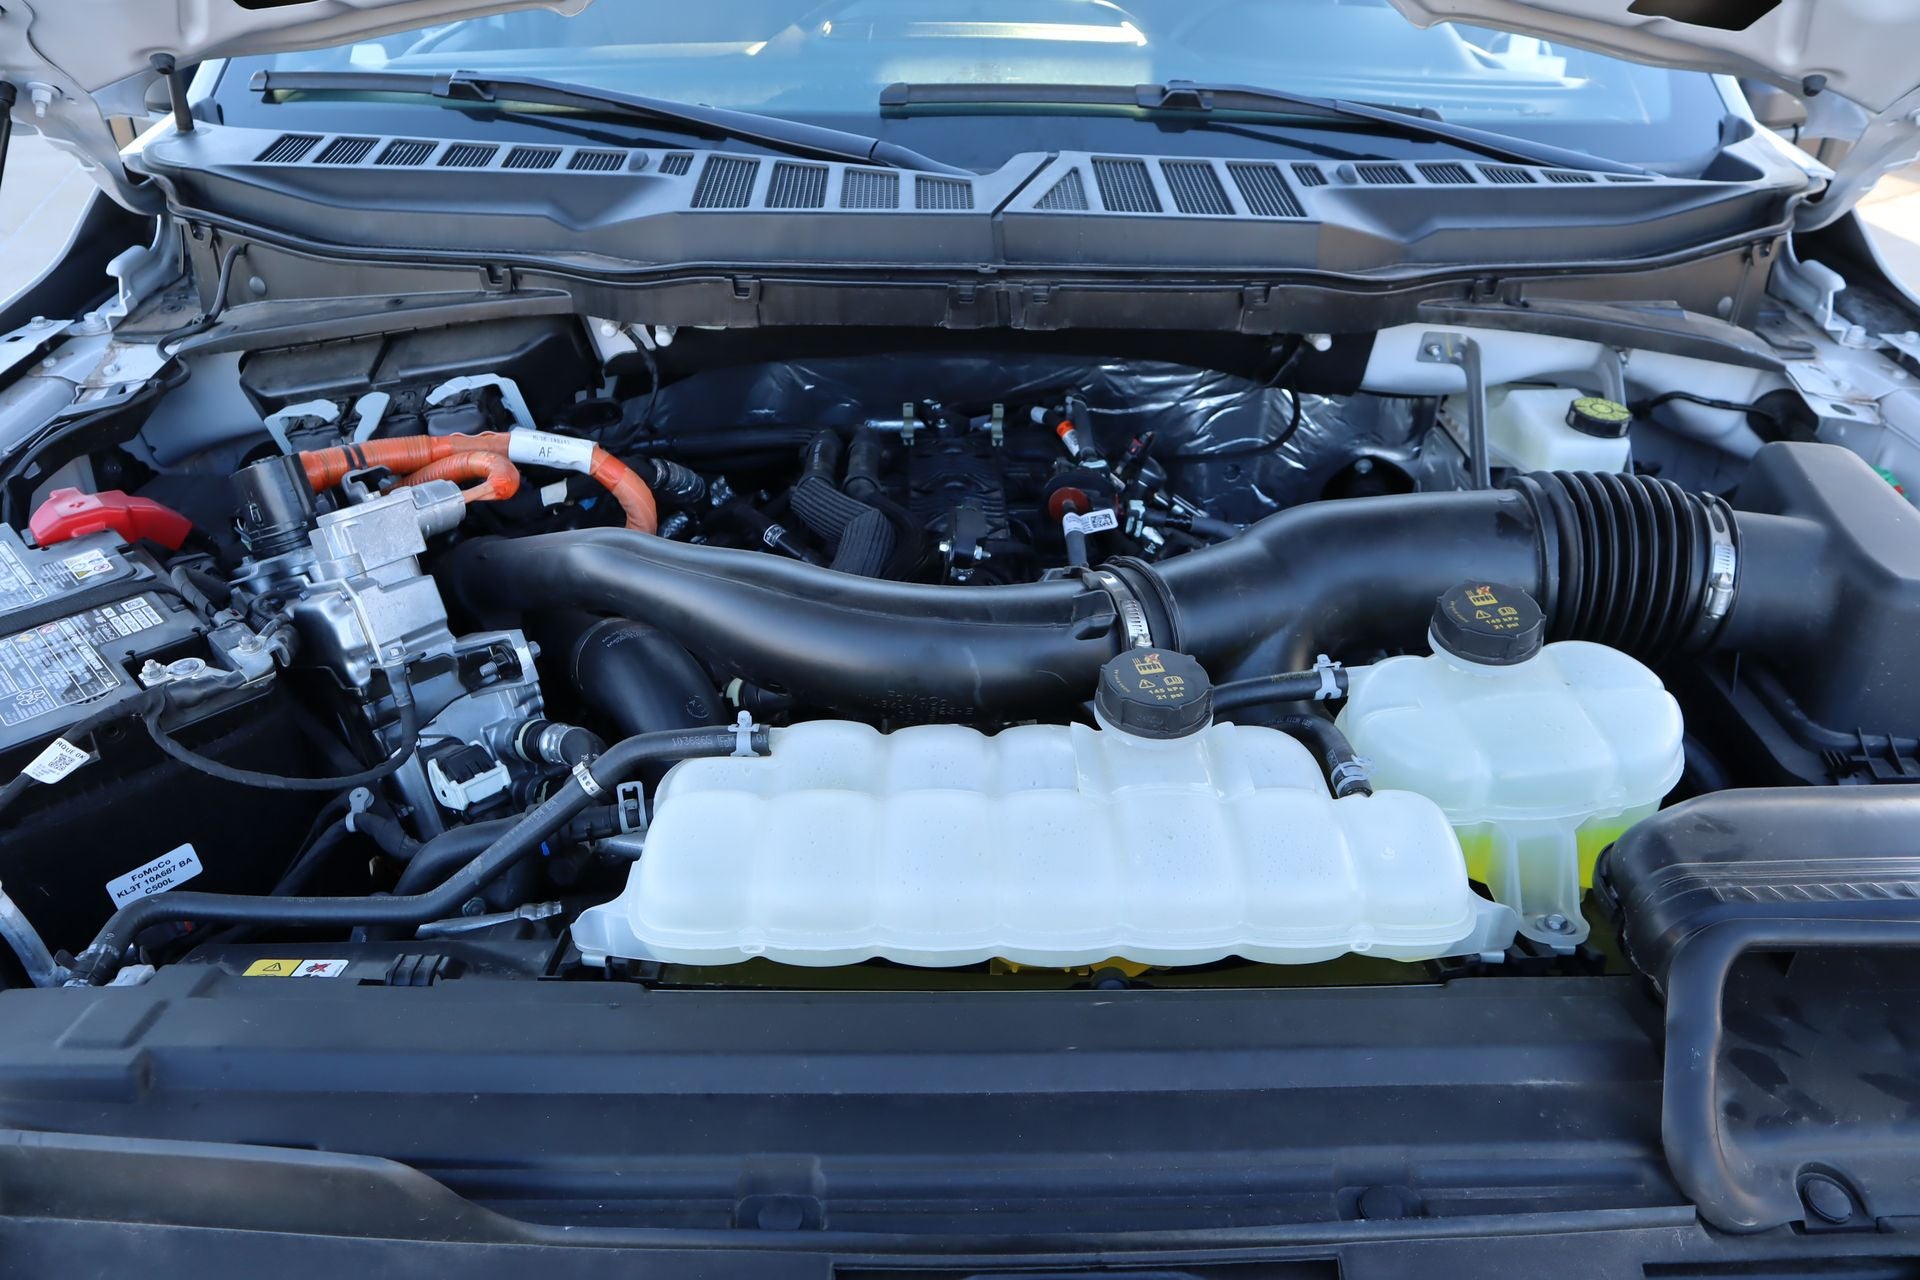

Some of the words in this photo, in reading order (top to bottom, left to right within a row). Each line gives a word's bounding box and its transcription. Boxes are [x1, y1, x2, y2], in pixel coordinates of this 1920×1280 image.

[538, 446, 553, 458] AF
[116, 883, 141, 899] KL3T
[144, 865, 177, 885] 10A687
[178, 857, 193, 868] BA
[130, 859, 171, 882] FoMoCo
[144, 877, 175, 895] C500L
